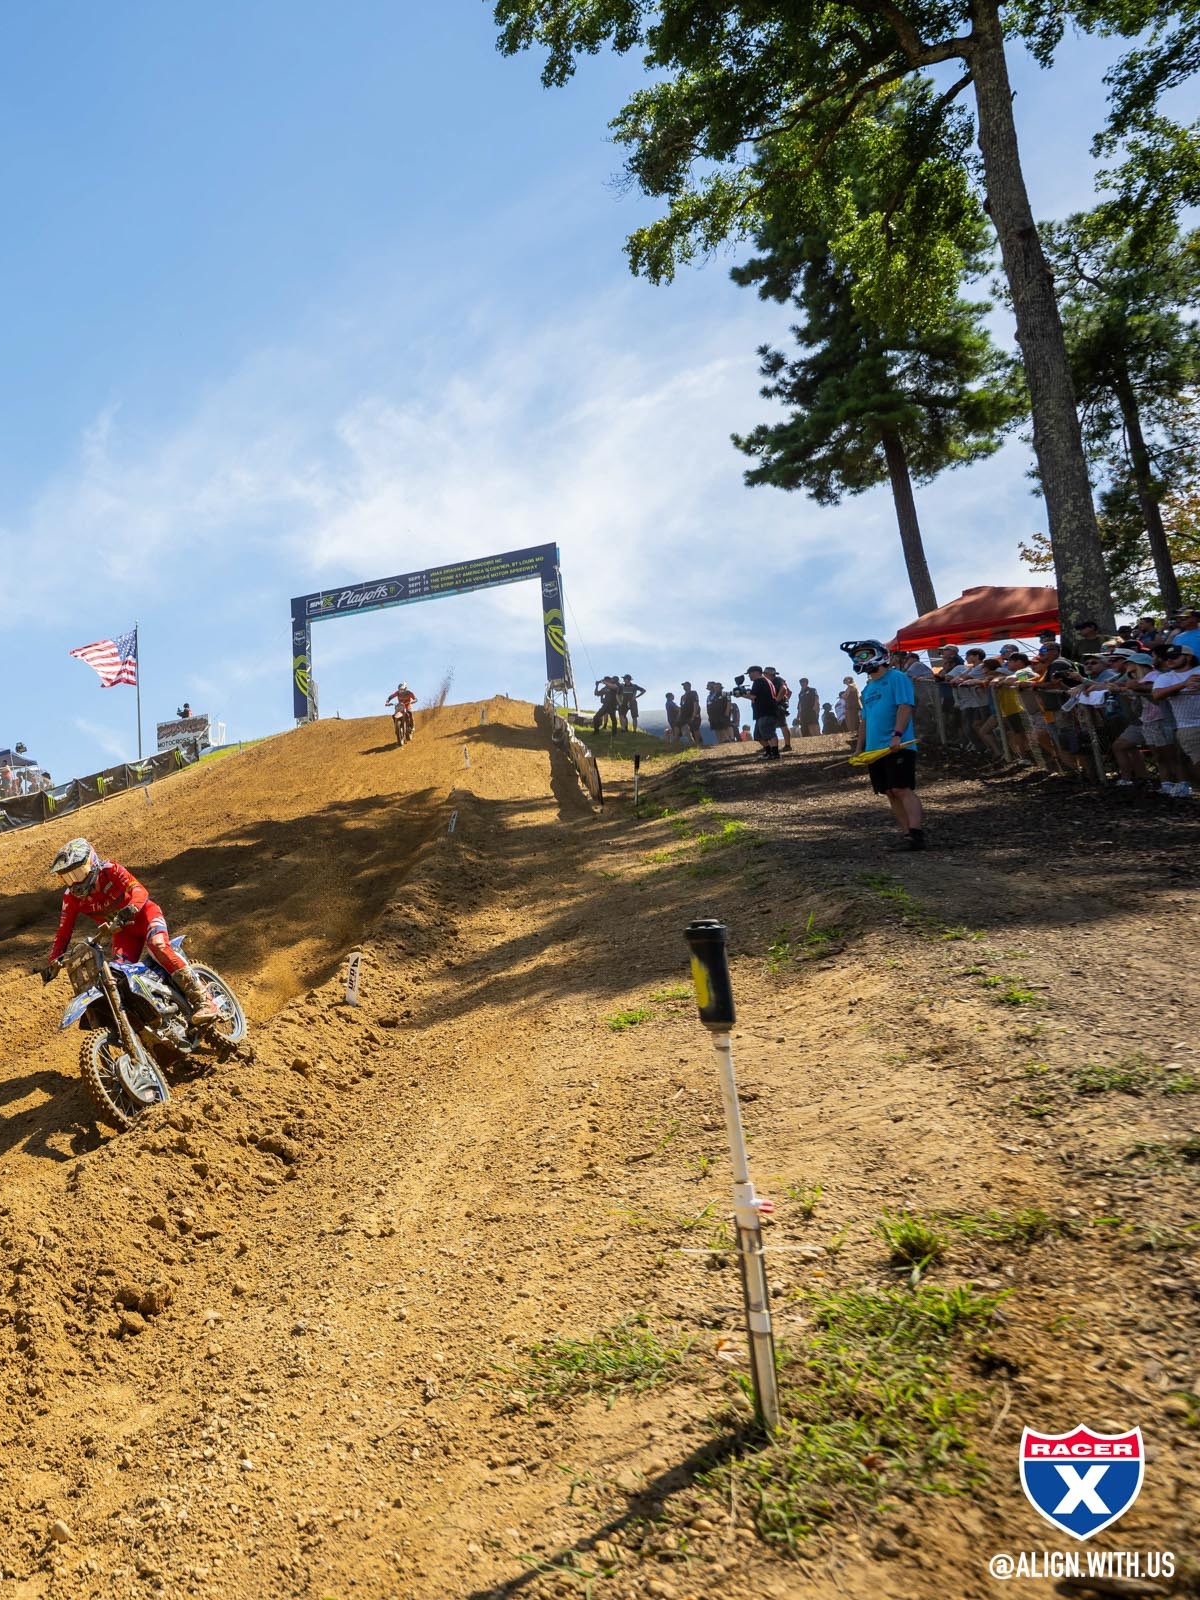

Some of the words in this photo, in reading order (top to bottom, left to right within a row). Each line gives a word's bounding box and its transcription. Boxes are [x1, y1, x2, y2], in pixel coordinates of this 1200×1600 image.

[510, 565, 538, 574] SPEEDWAY
[337, 585, 388, 608] Playoffs
[158, 737, 190, 747] MOTOCROSS
